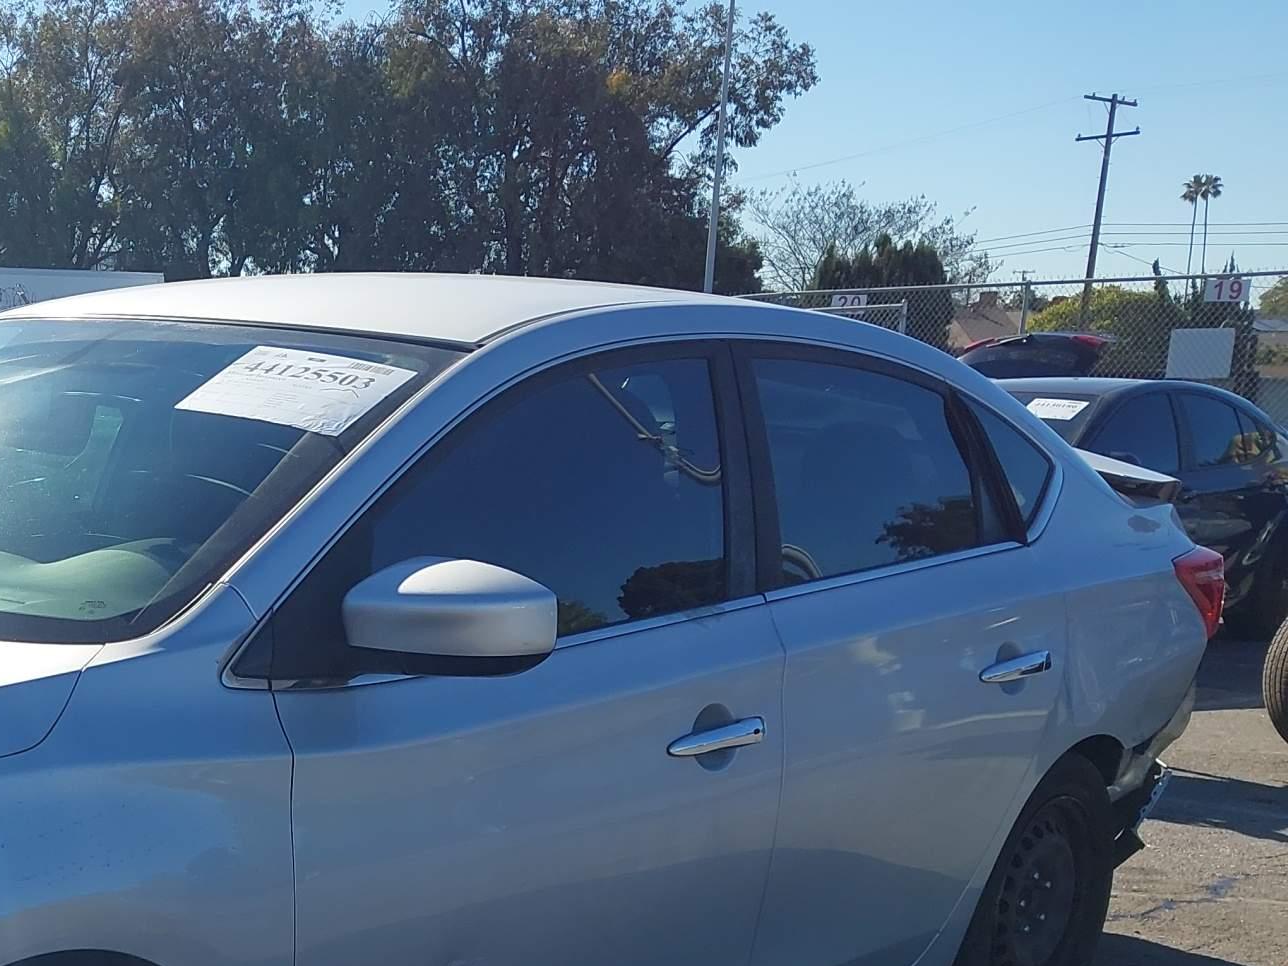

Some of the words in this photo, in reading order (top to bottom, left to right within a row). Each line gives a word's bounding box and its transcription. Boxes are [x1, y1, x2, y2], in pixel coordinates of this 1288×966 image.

[1214, 280, 1242, 300] 19
[838, 295, 861, 307] 20
[243, 361, 376, 390] 44125503
